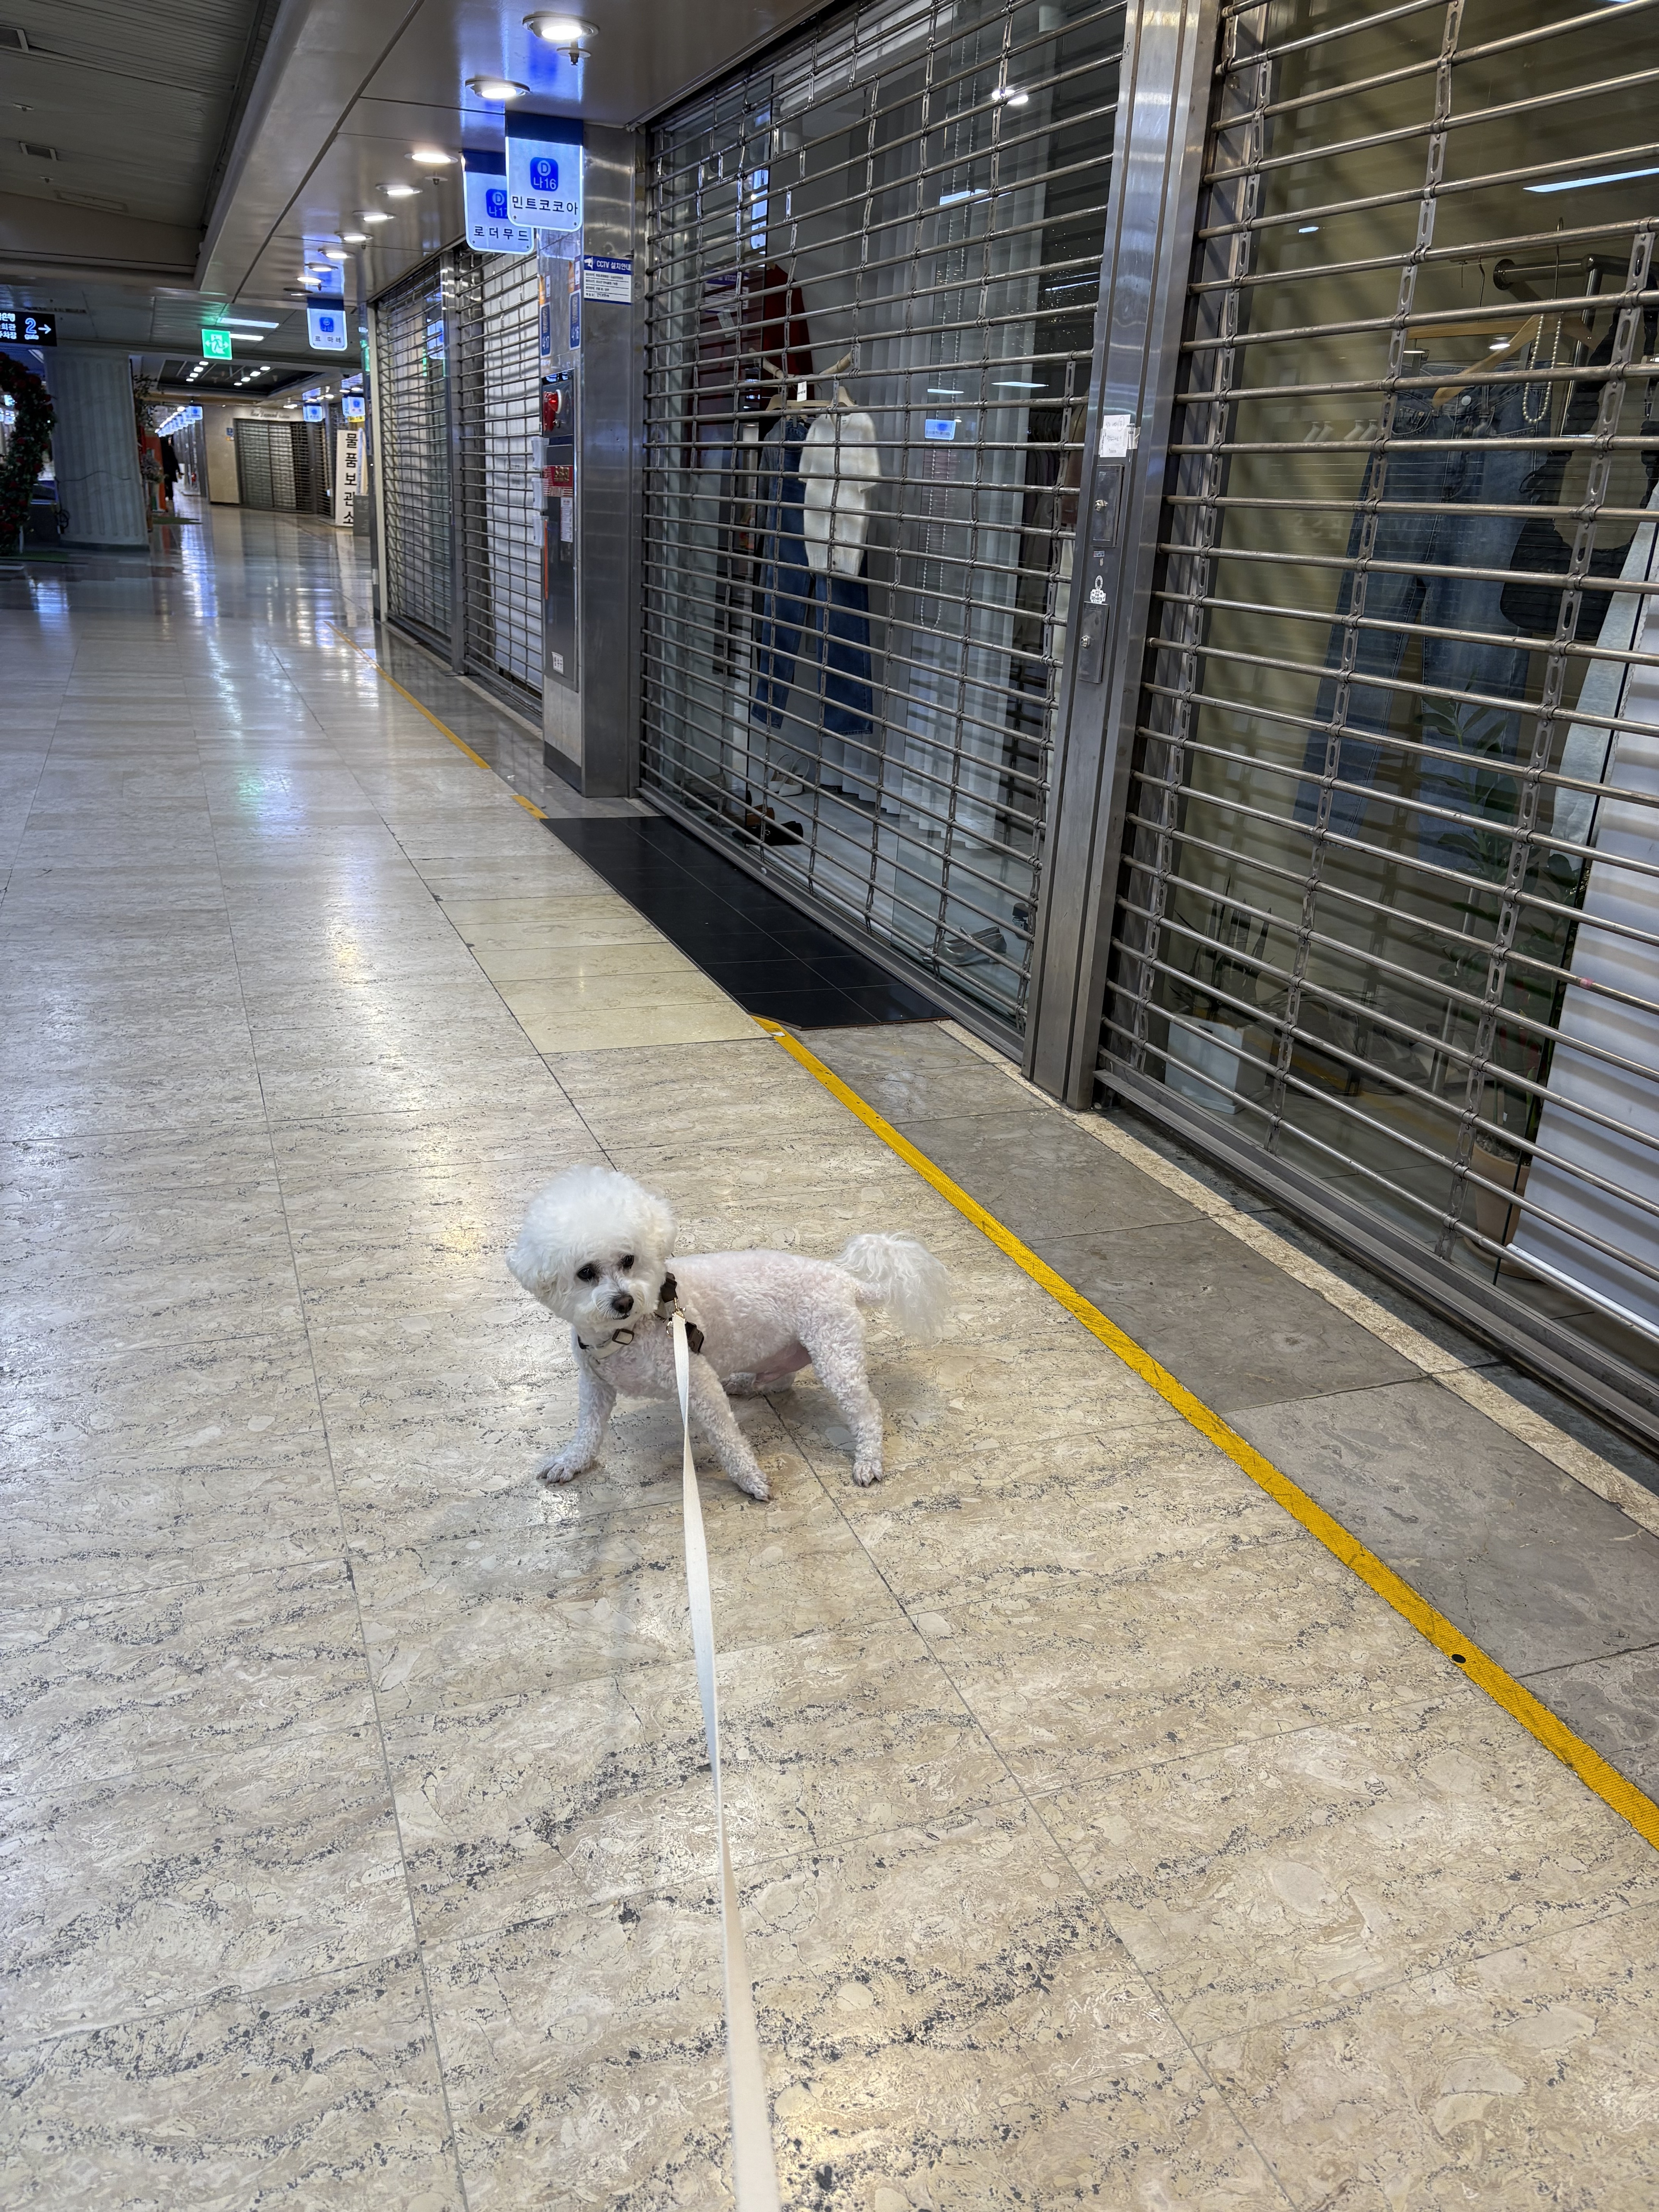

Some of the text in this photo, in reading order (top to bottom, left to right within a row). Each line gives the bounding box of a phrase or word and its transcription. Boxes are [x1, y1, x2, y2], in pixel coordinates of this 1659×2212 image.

[533, 177, 556, 189] 나16
[512, 196, 578, 215] 민트코코아
[596, 260, 610, 268] CCTV
[0, 313, 15, 322] 은행
[25, 318, 37, 334] 2
[342, 433, 358, 524] 물품보관소
